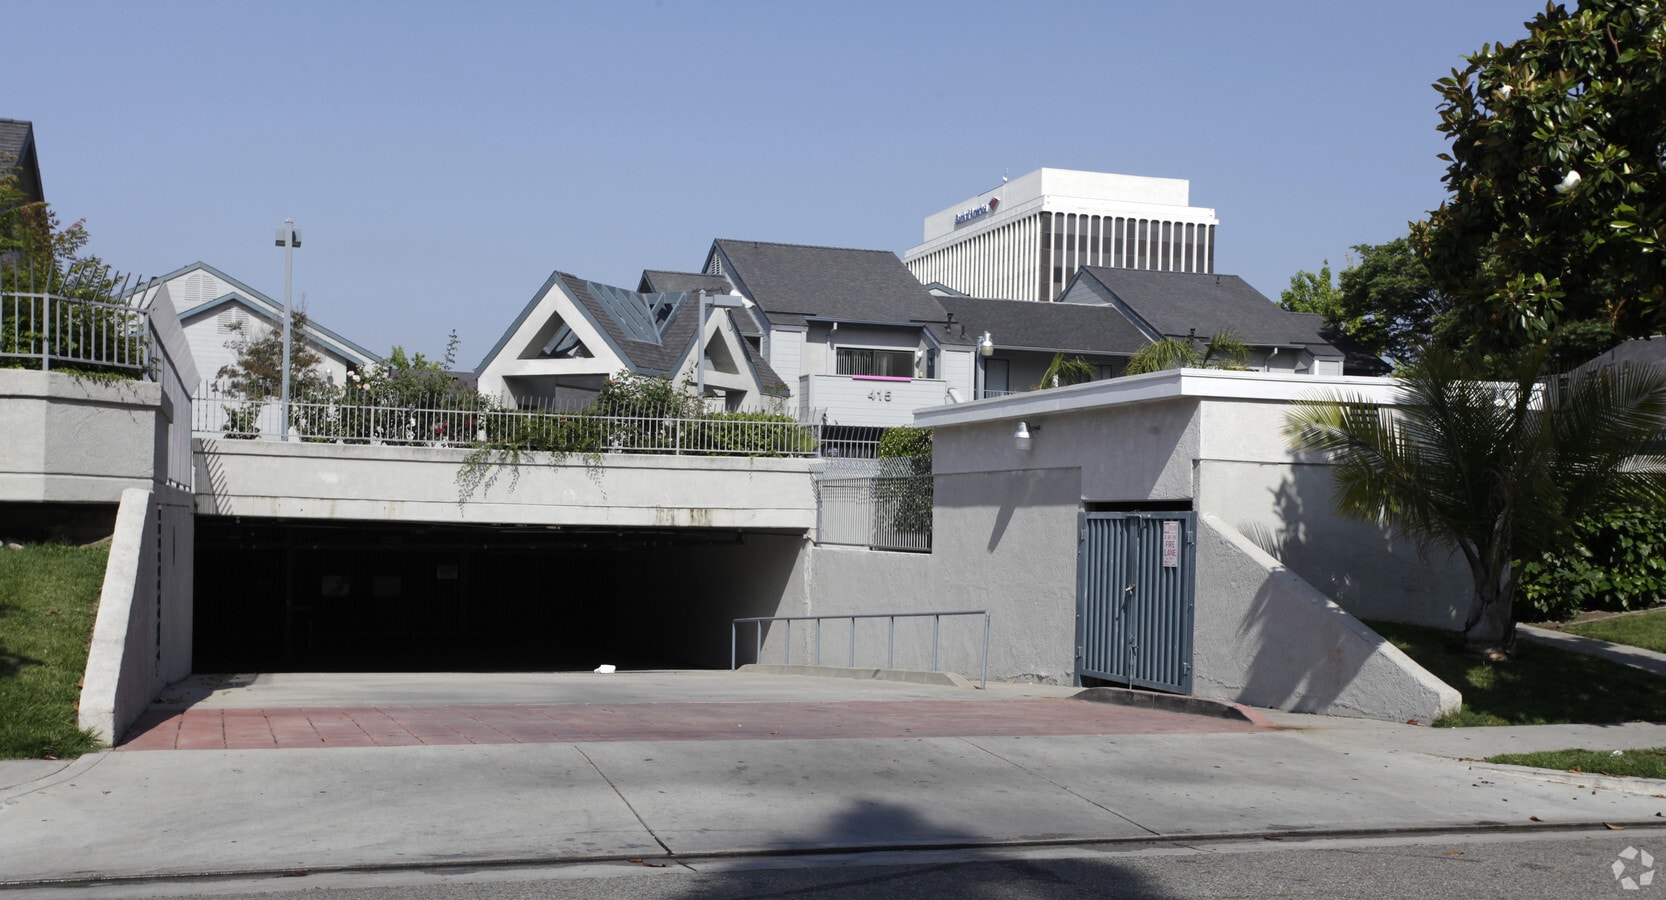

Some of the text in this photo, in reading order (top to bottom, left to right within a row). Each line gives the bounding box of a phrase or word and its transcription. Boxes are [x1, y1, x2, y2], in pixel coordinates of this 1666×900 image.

[867, 390, 892, 402] 415
[1165, 540, 1175, 549] FIRE
[1164, 549, 1176, 557] LANE
